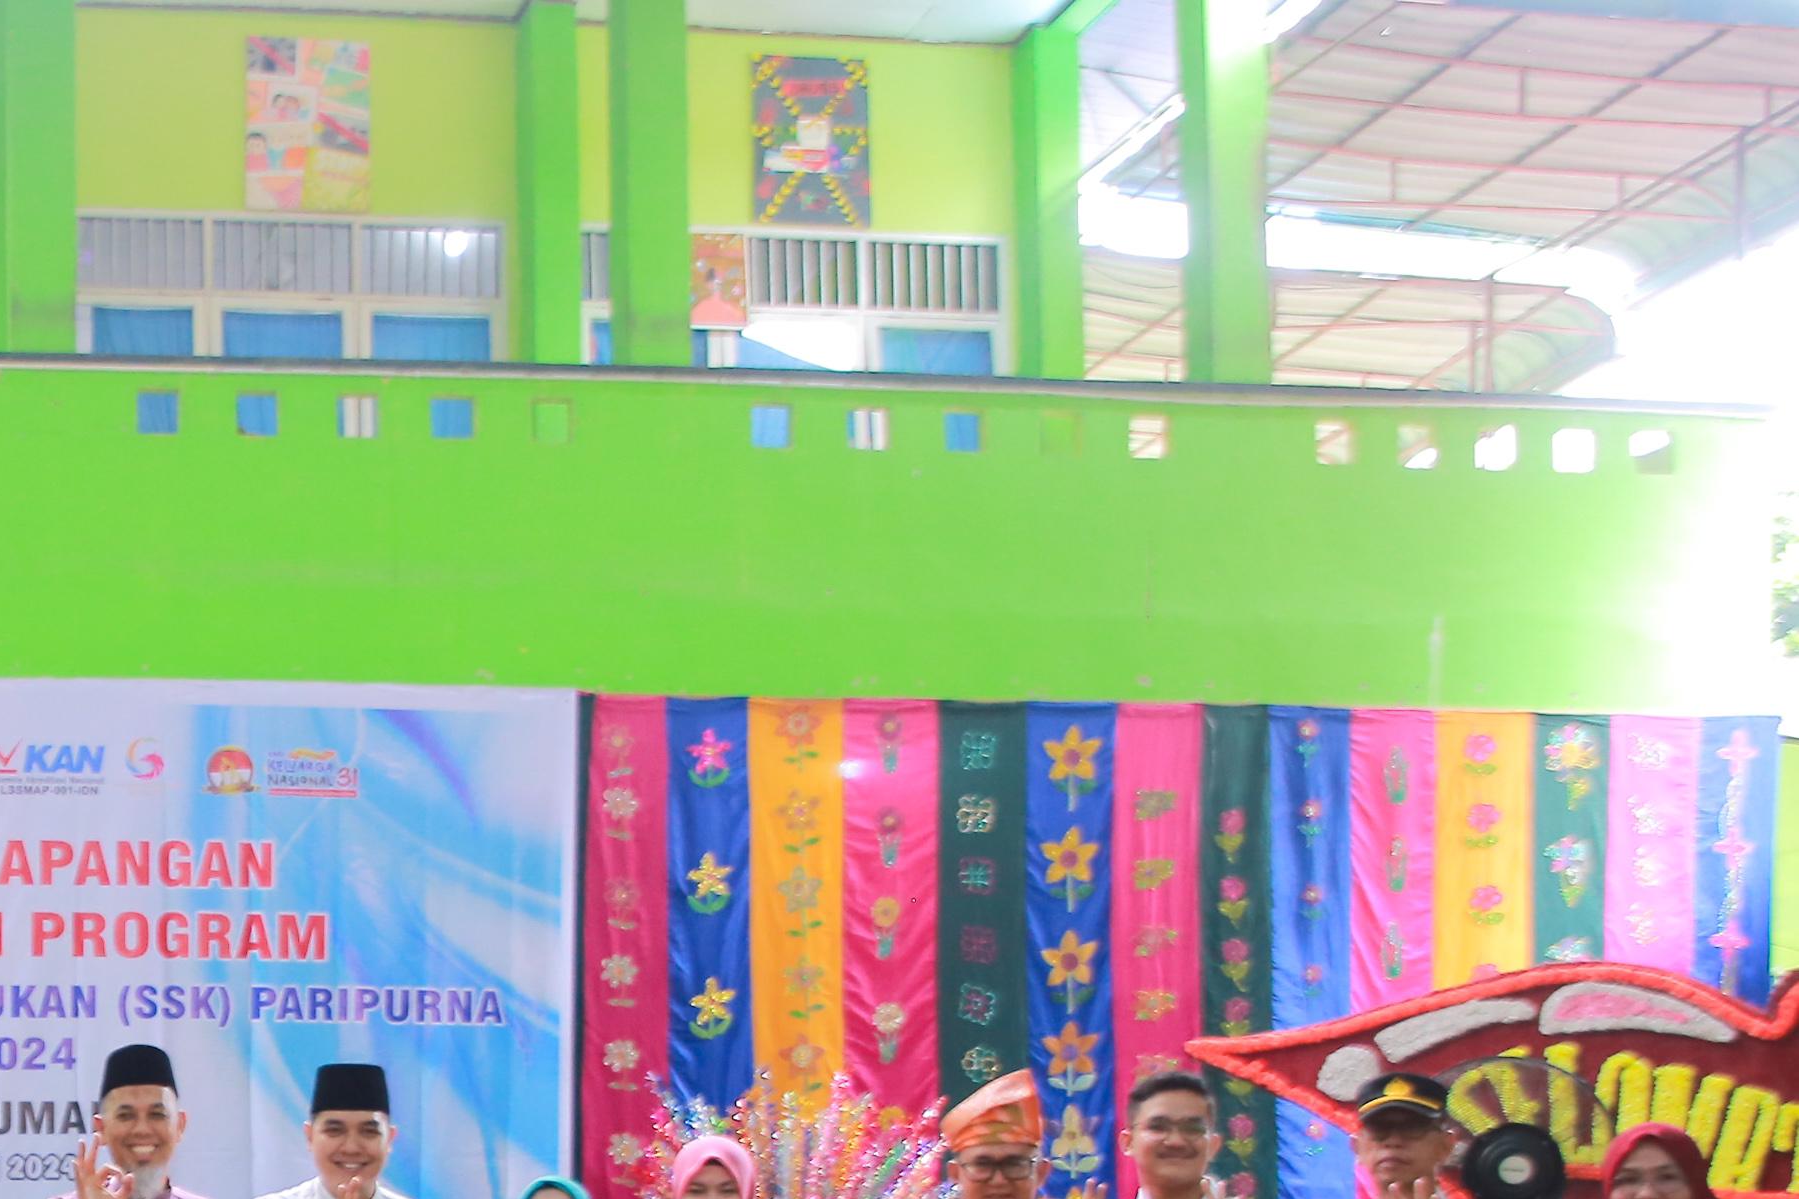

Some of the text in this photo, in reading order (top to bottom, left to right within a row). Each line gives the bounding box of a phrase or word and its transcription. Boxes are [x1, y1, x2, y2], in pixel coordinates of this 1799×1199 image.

[23, 744, 106, 774] KAN
[267, 774, 334, 787] NASIONAL
[336, 766, 359, 788] 31
[30, 911, 328, 962] PROGRAM
[117, 984, 232, 1028] (SSK)
[250, 986, 506, 1026] PARIPURNA
